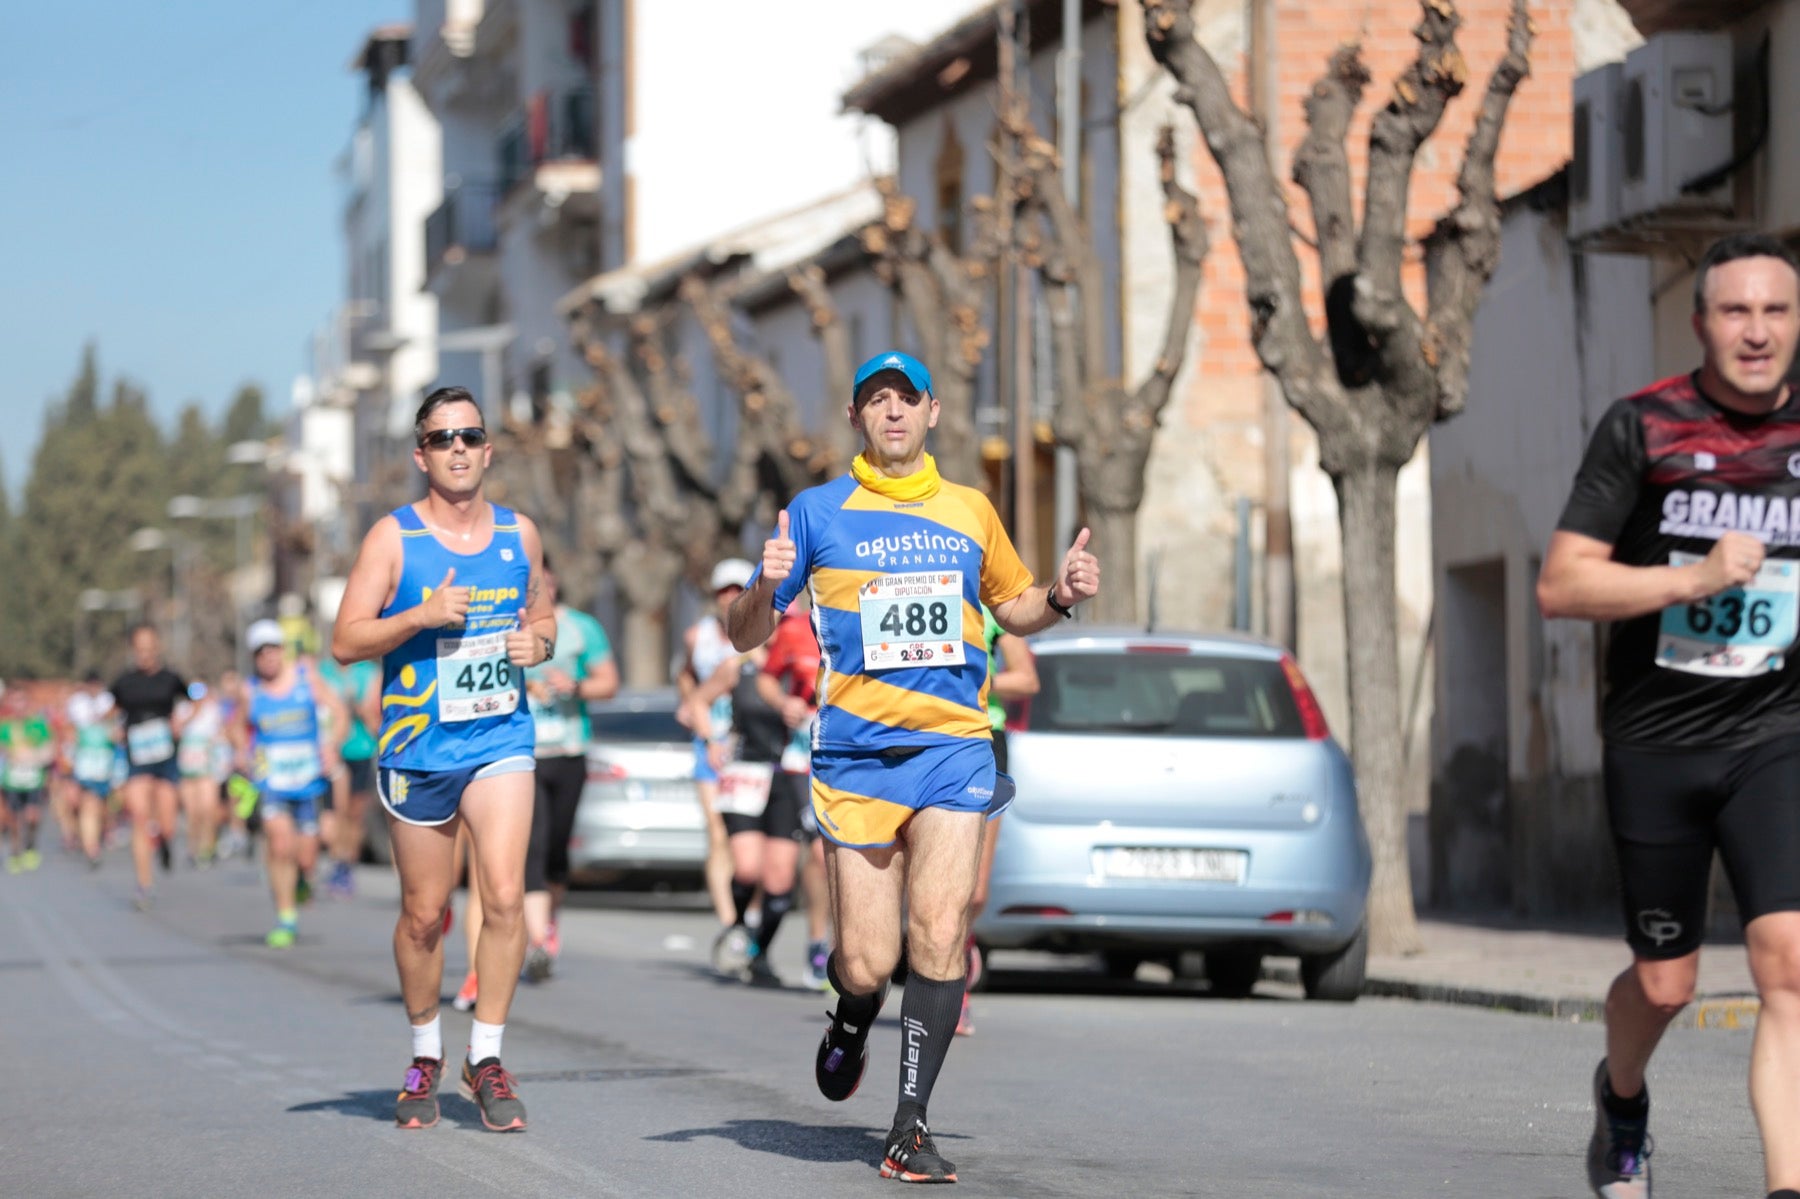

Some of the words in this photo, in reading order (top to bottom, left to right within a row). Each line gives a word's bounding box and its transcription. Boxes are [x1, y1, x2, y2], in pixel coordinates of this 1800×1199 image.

[855, 530, 970, 558] agustinos
[877, 554, 959, 567] GRANADA
[885, 576, 903, 587] GRAN
[904, 575, 928, 585] PREMIO
[929, 574, 936, 584] DE
[880, 602, 949, 636] 488
[1687, 596, 1772, 638] 636
[456, 659, 510, 692] 426
